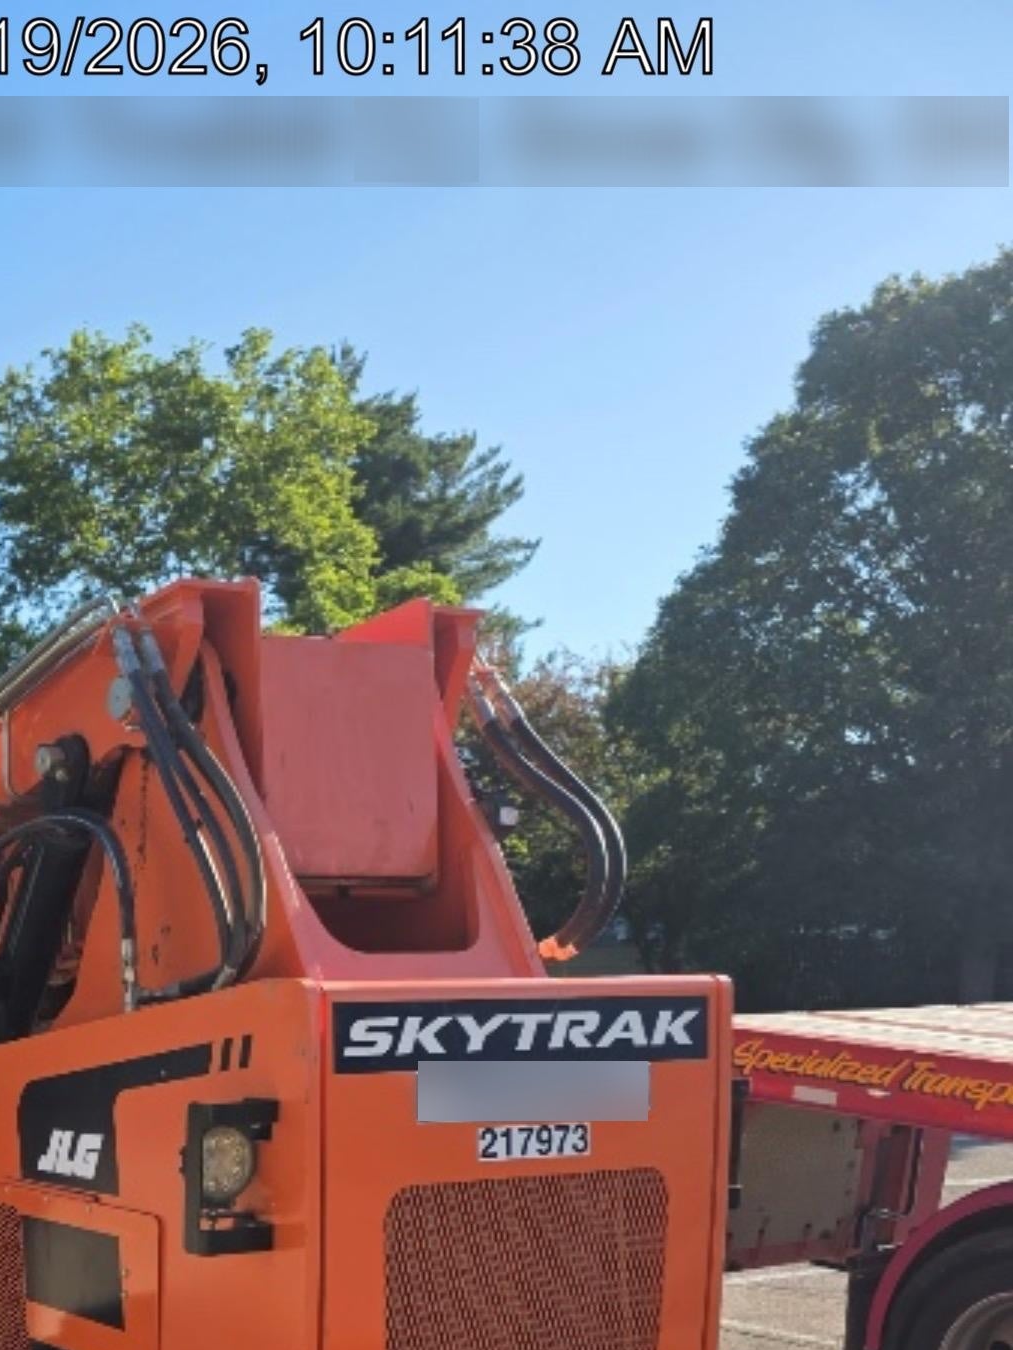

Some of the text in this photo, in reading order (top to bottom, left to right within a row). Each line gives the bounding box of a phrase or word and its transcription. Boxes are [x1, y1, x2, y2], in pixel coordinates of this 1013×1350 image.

[343, 1009, 699, 1057] SKYTRAK
[734, 1037, 909, 1087] Specialized
[37, 1128, 104, 1180] JLG
[480, 1124, 588, 1158] 217973
